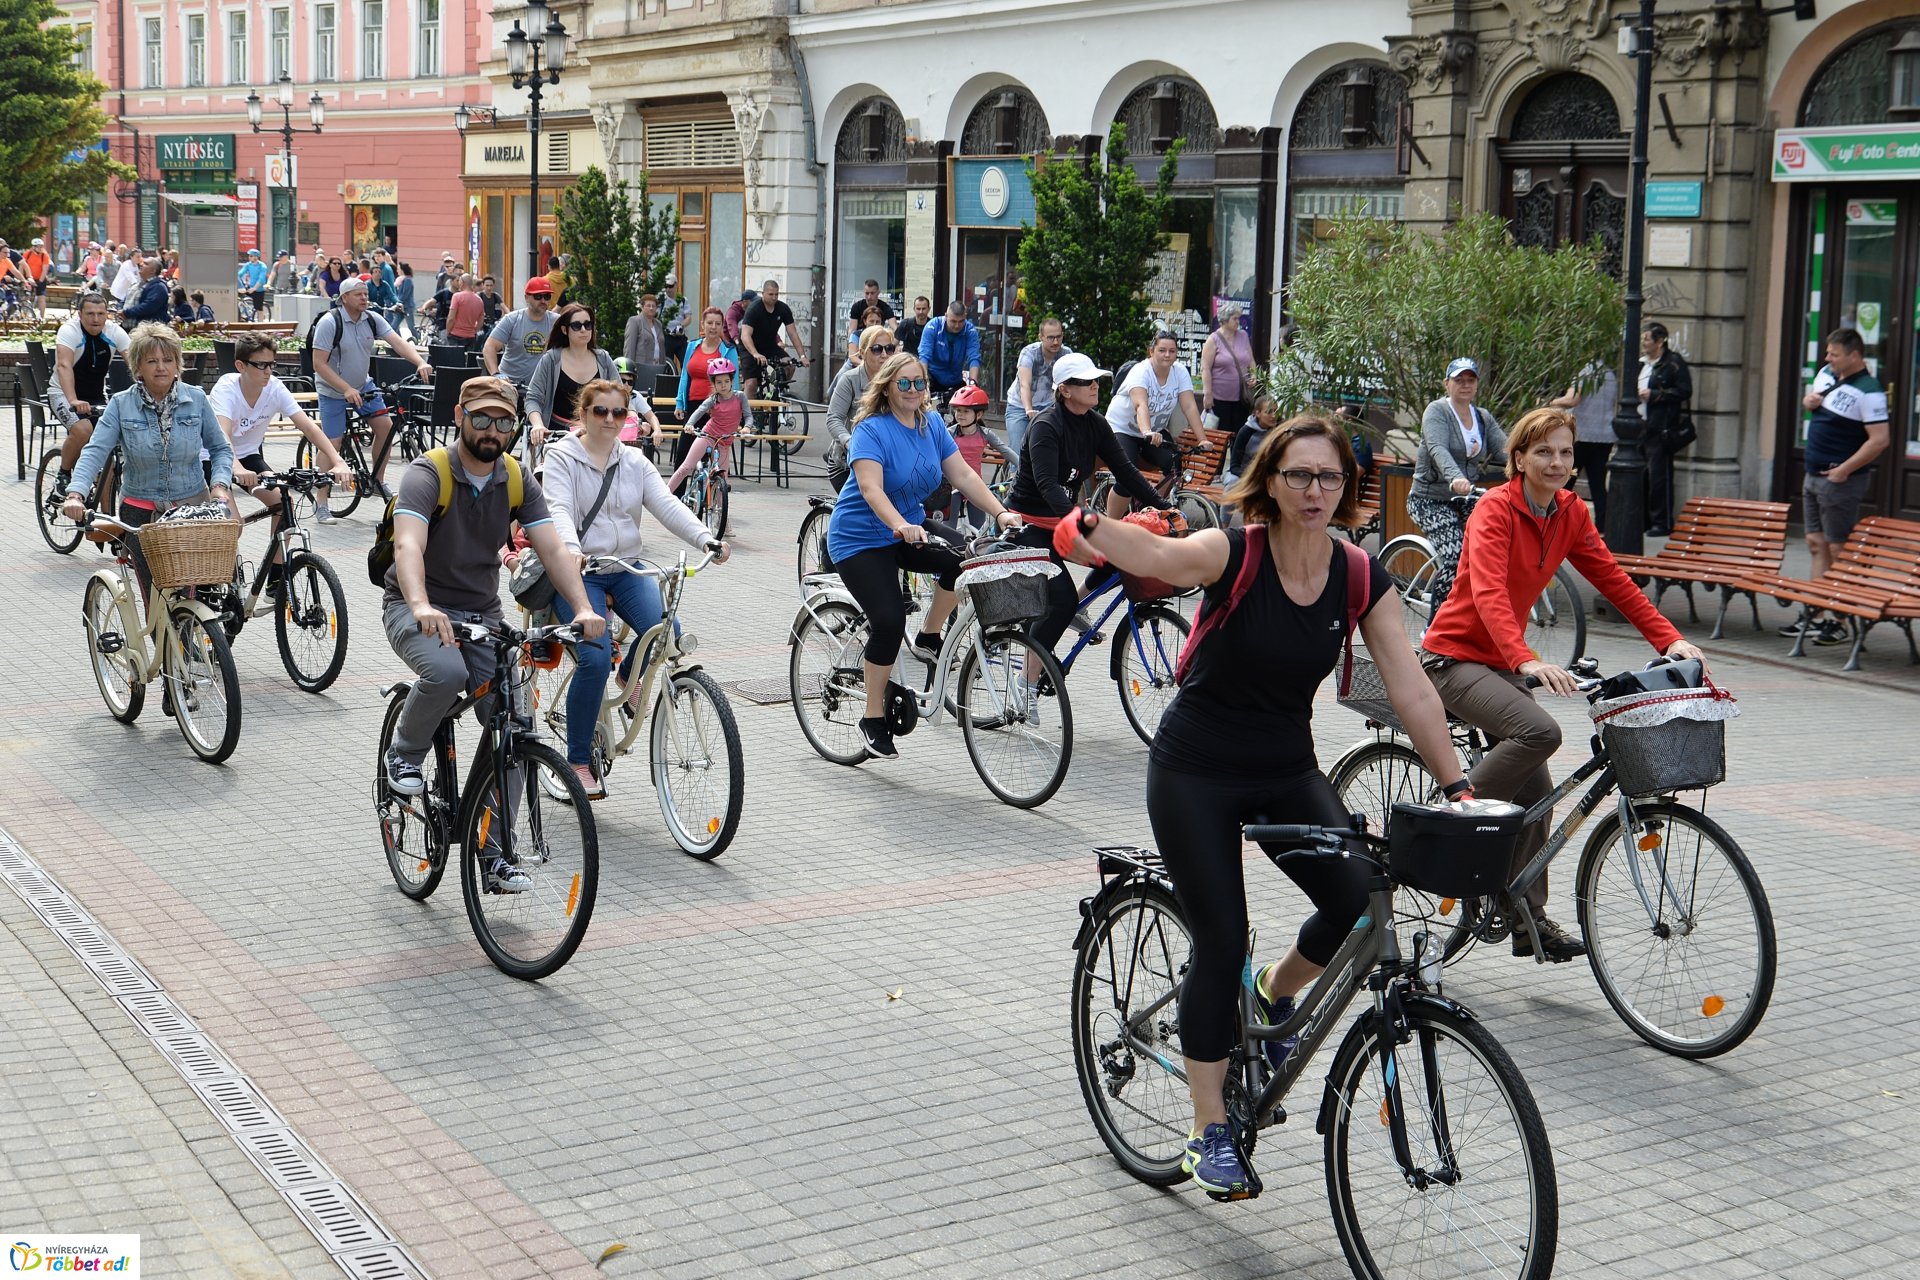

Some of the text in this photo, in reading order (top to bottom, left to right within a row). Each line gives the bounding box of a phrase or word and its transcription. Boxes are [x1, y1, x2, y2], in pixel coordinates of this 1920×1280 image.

[163, 136, 225, 160] NYÍRSÉG
[484, 145, 525, 162] MARELLA
[1829, 144, 1855, 164] Fuji
[1854, 144, 1884, 160] Foto
[201, 160, 224, 168] IRODA
